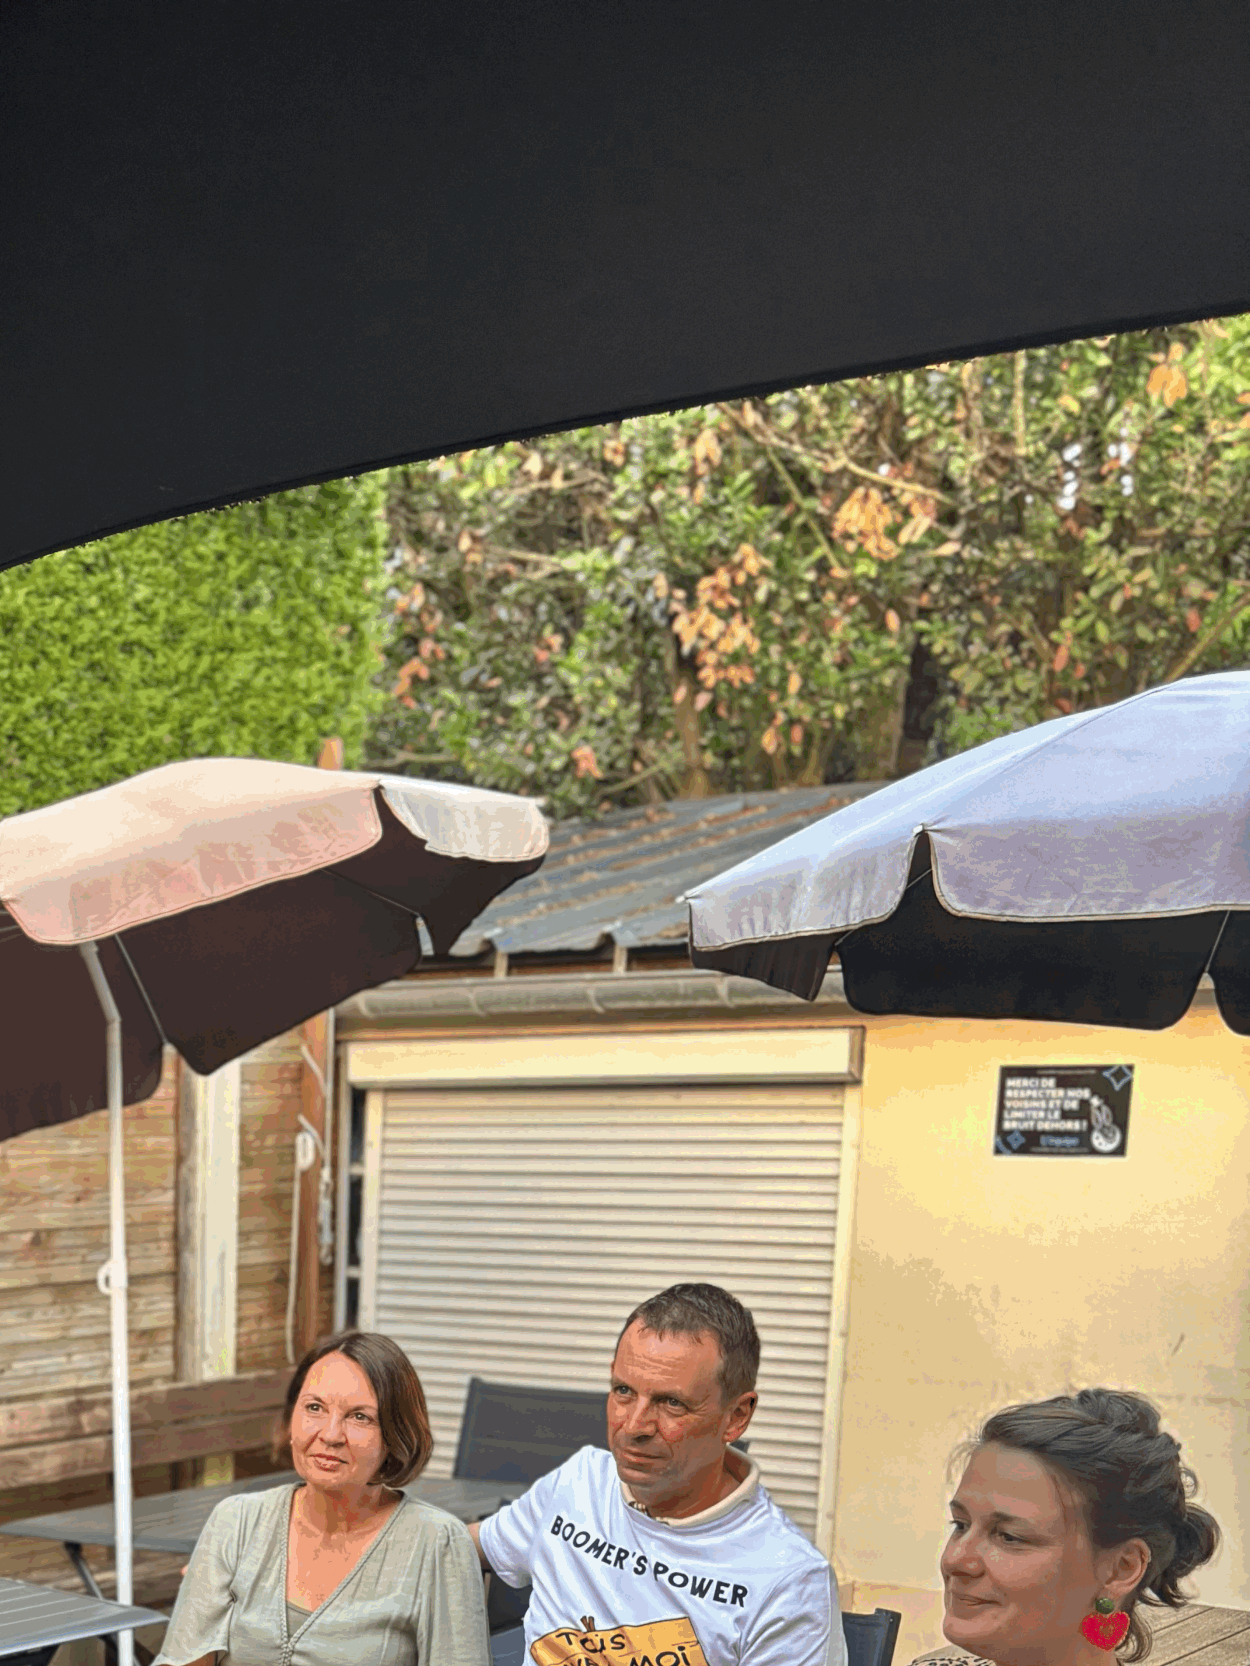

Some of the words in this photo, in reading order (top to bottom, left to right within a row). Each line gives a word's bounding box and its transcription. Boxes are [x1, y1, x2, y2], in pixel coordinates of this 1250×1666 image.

[1006, 1077, 1039, 1087] MERCI
[1041, 1077, 1056, 1088] DE
[1005, 1088, 1065, 1098] RESPECTER
[1066, 1088, 1090, 1099] NOS
[1005, 1099, 1046, 1109] VOISINS
[1048, 1099, 1062, 1109] ET
[1063, 1099, 1079, 1110] DE
[1004, 1110, 1045, 1119] LIMITER
[1047, 1110, 1061, 1119] LE
[1003, 1120, 1035, 1130] BRUIT
[1036, 1120, 1080, 1130] DEHORS
[550, 1515, 648, 1576] BOOMER'S
[653, 1561, 749, 1608] POWER
